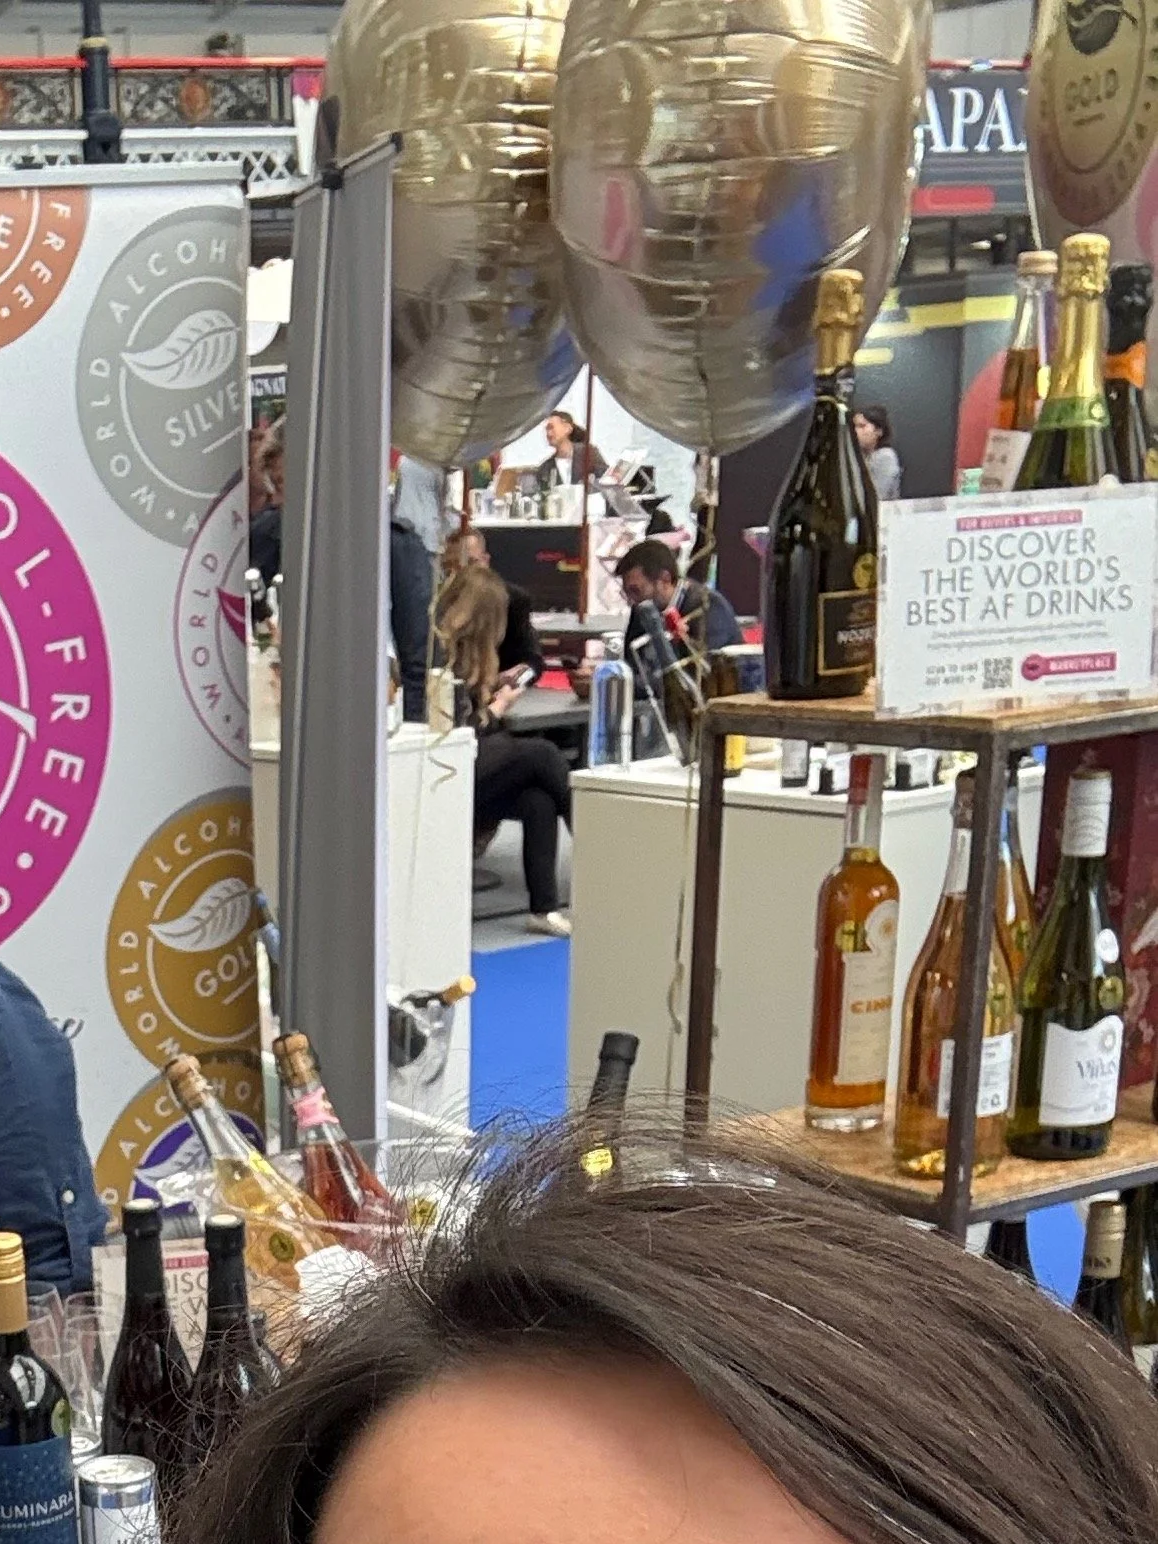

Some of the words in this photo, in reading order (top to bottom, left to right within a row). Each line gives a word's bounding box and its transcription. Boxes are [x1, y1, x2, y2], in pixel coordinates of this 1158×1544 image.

[918, 86, 1027, 153] APA
[89, 356, 158, 514] WORLD
[946, 527, 1096, 564] DISCOVER
[920, 567, 974, 596] THE
[983, 555, 1121, 590] WORLD'S
[189, 552, 223, 710] WORLD
[906, 595, 971, 627] BEST
[979, 592, 1015, 622] AF
[1026, 583, 1134, 618] DRINKS
